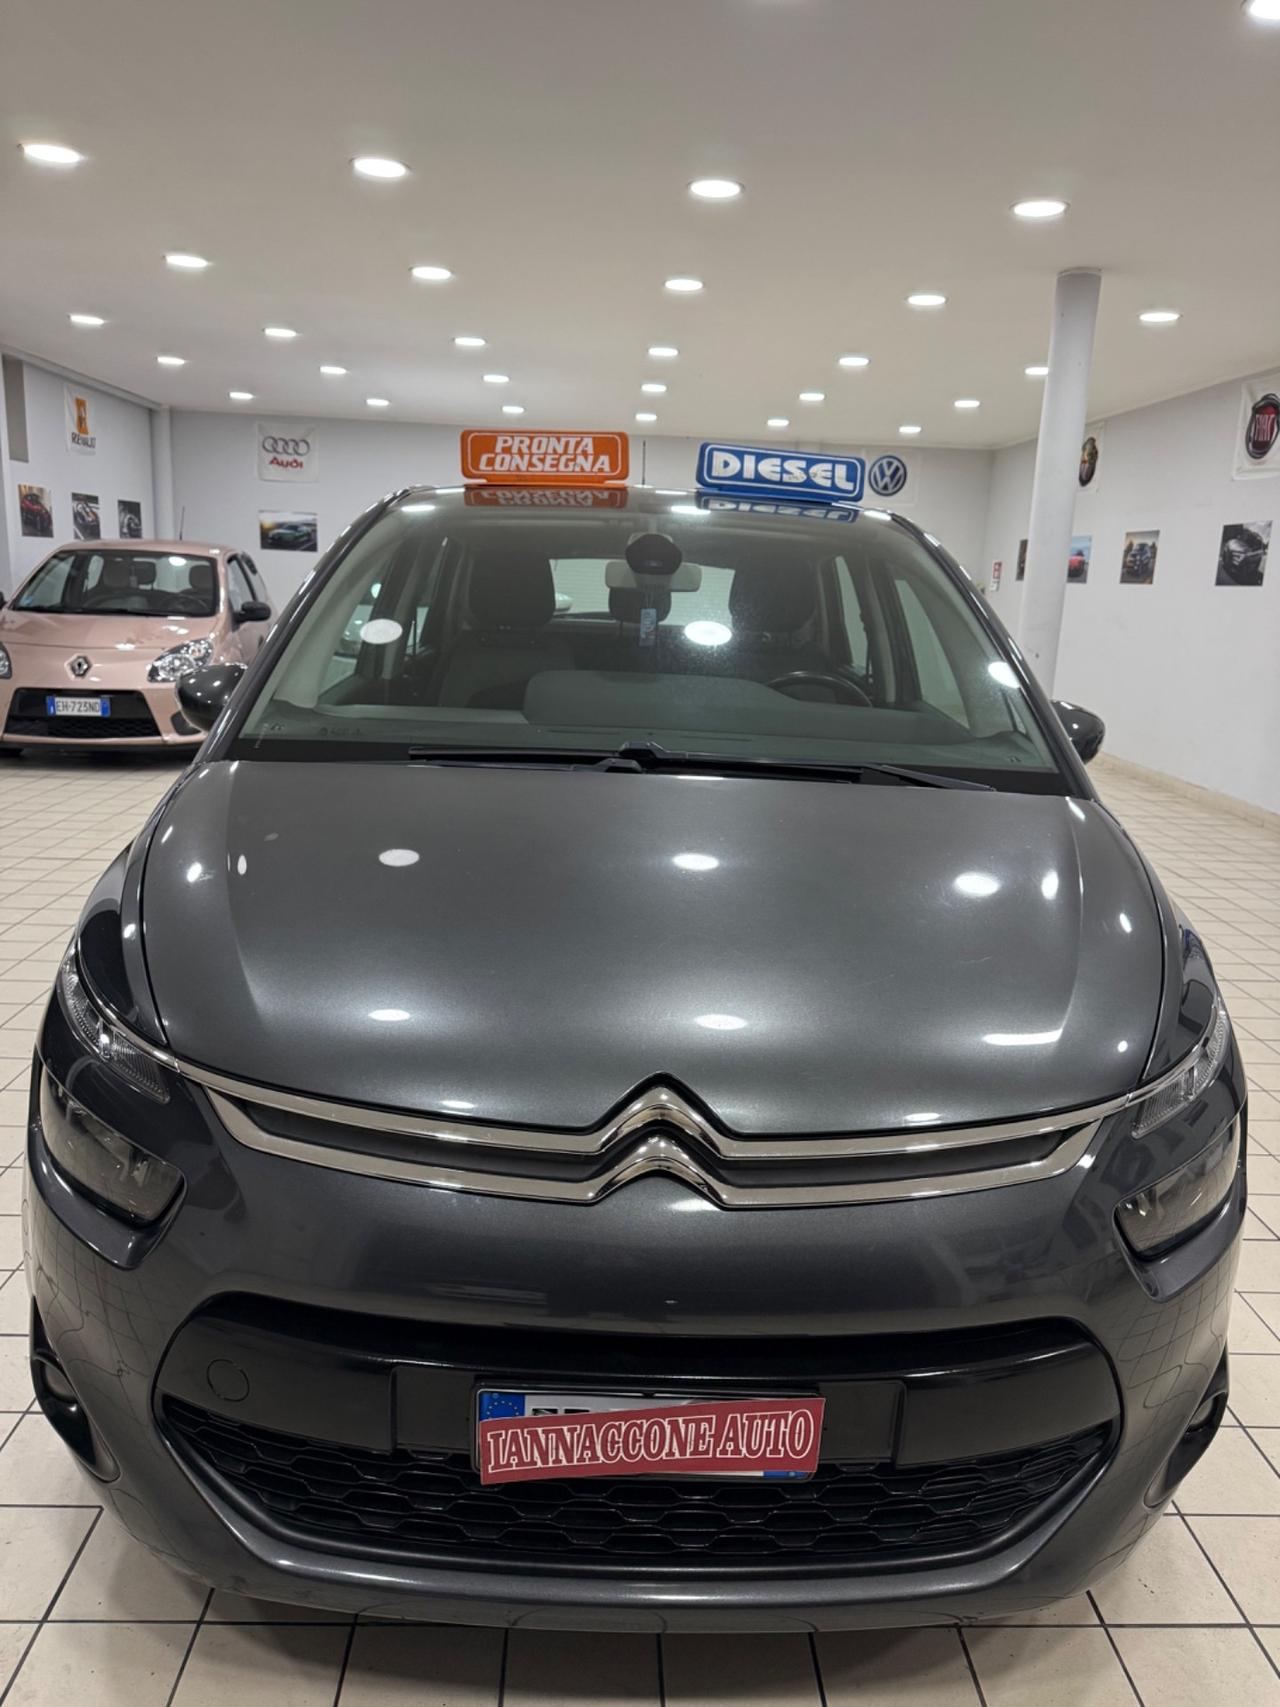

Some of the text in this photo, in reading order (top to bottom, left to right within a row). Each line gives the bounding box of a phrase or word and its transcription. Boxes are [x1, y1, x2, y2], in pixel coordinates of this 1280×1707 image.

[1255, 414, 1276, 441] FIAT
[495, 436, 594, 454] PRONTA
[269, 456, 304, 468] Audi
[479, 453, 611, 472] CONSEGNA
[711, 451, 855, 491] DIESEL
[487, 1409, 815, 1473] IANNACCONE AUTO
